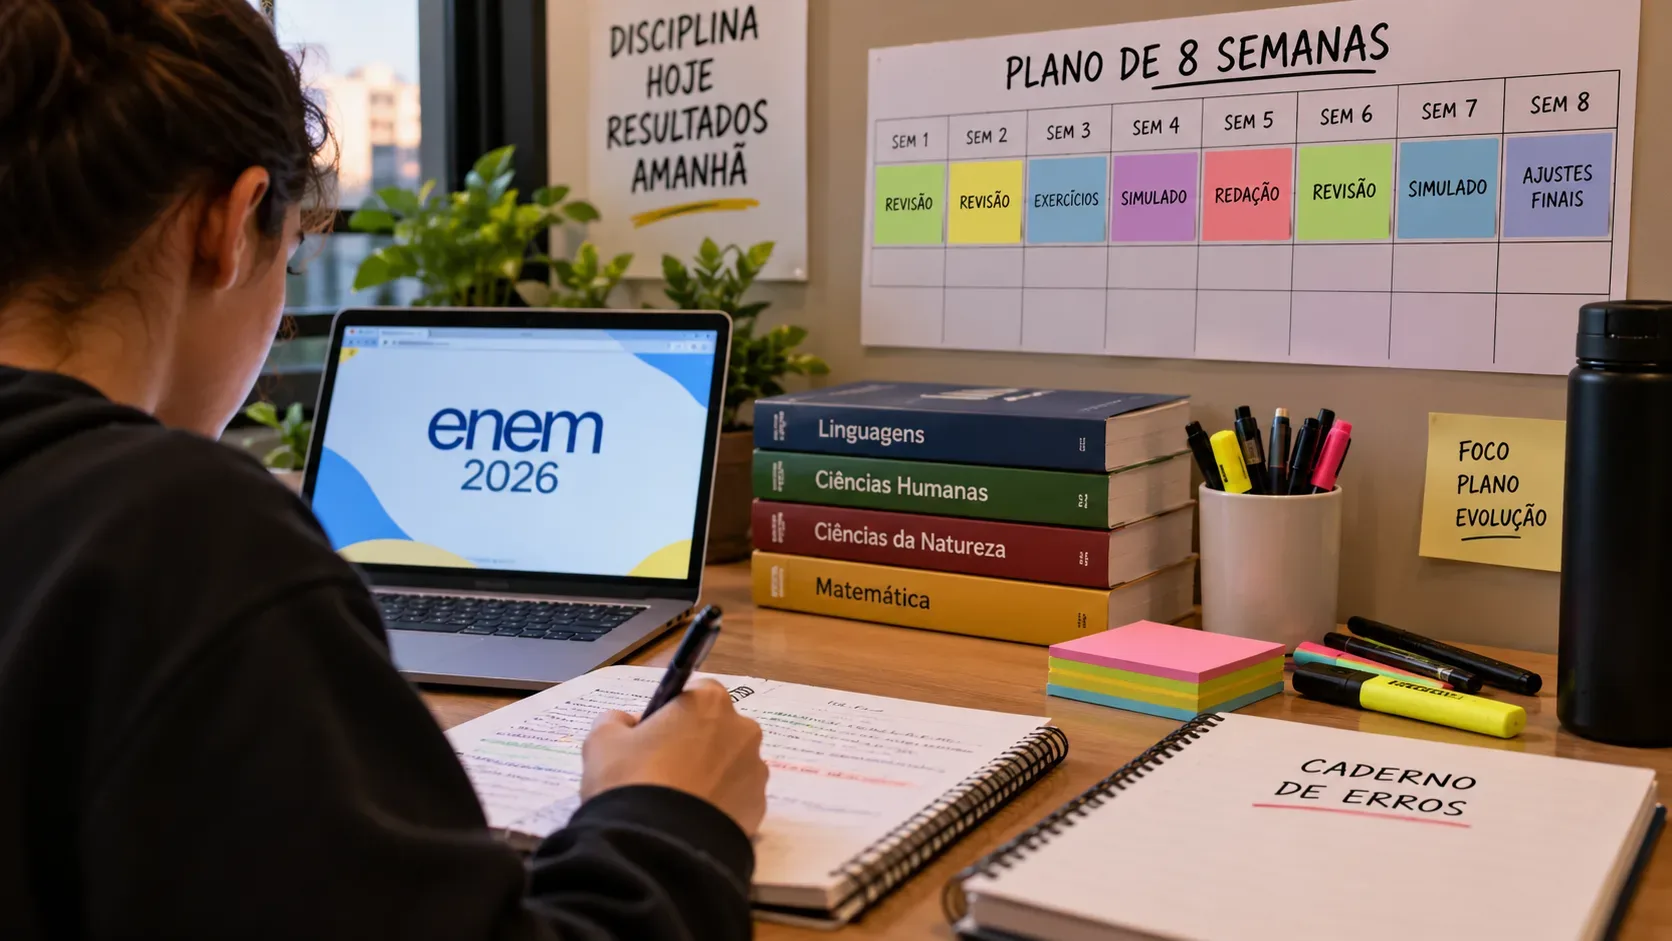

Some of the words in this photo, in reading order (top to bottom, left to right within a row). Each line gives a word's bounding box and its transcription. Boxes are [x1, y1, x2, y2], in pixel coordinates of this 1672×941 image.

[610, 6, 758, 57] DISCIPLINA
[1007, 50, 1103, 90] PLANO
[1120, 44, 1160, 81] DE
[1179, 39, 1198, 76] 8
[1217, 23, 1389, 72] SEMANAS
[647, 58, 713, 97] HOJE
[1422, 102, 1456, 120] SEM
[1466, 99, 1477, 117] 7
[1531, 96, 1567, 114] SEM
[1579, 92, 1589, 111] 8
[608, 99, 767, 148] RESULTADOS
[1133, 120, 1161, 135] SEM
[1170, 117, 1179, 134] 4
[1225, 115, 1255, 130] SEM
[1264, 111, 1273, 128] 5
[1321, 108, 1352, 125] SEM
[1362, 105, 1372, 123] 6
[893, 135, 916, 149] SEM
[923, 132, 929, 148] 1
[967, 130, 991, 144] SEM
[999, 127, 1007, 142] 2
[1047, 125, 1074, 140] SEM
[1082, 122, 1090, 138] 3
[631, 142, 747, 193] AMANHÃ
[1523, 164, 1592, 184] AJUSTES
[1035, 190, 1098, 207] EXERCÍCIOS
[1122, 190, 1187, 205] SIMULADO
[1216, 182, 1279, 206] REDAÇÃO
[1313, 178, 1376, 200] REVISÃO
[1409, 179, 1487, 197] SIMULADO
[1532, 190, 1583, 208] FINAIS
[886, 193, 932, 211] REVISÃO
[960, 191, 1009, 209] REVISÃO
[428, 408, 603, 453] enem
[819, 419, 924, 446] Linguagens
[1460, 440, 1509, 461] FOCO
[461, 459, 558, 493] 2026
[816, 470, 891, 493] Ciências
[898, 476, 988, 501] Humanas
[1458, 475, 1519, 494] PLANO
[1456, 504, 1547, 531] EVOLUÇÃO
[815, 522, 887, 546] Ciências
[893, 529, 914, 549] da
[922, 532, 1005, 558] Natureza
[816, 577, 929, 609] Matemática
[1300, 759, 1476, 790] CADERNO
[1275, 782, 1327, 799] DE
[1342, 788, 1467, 817] ERROS
